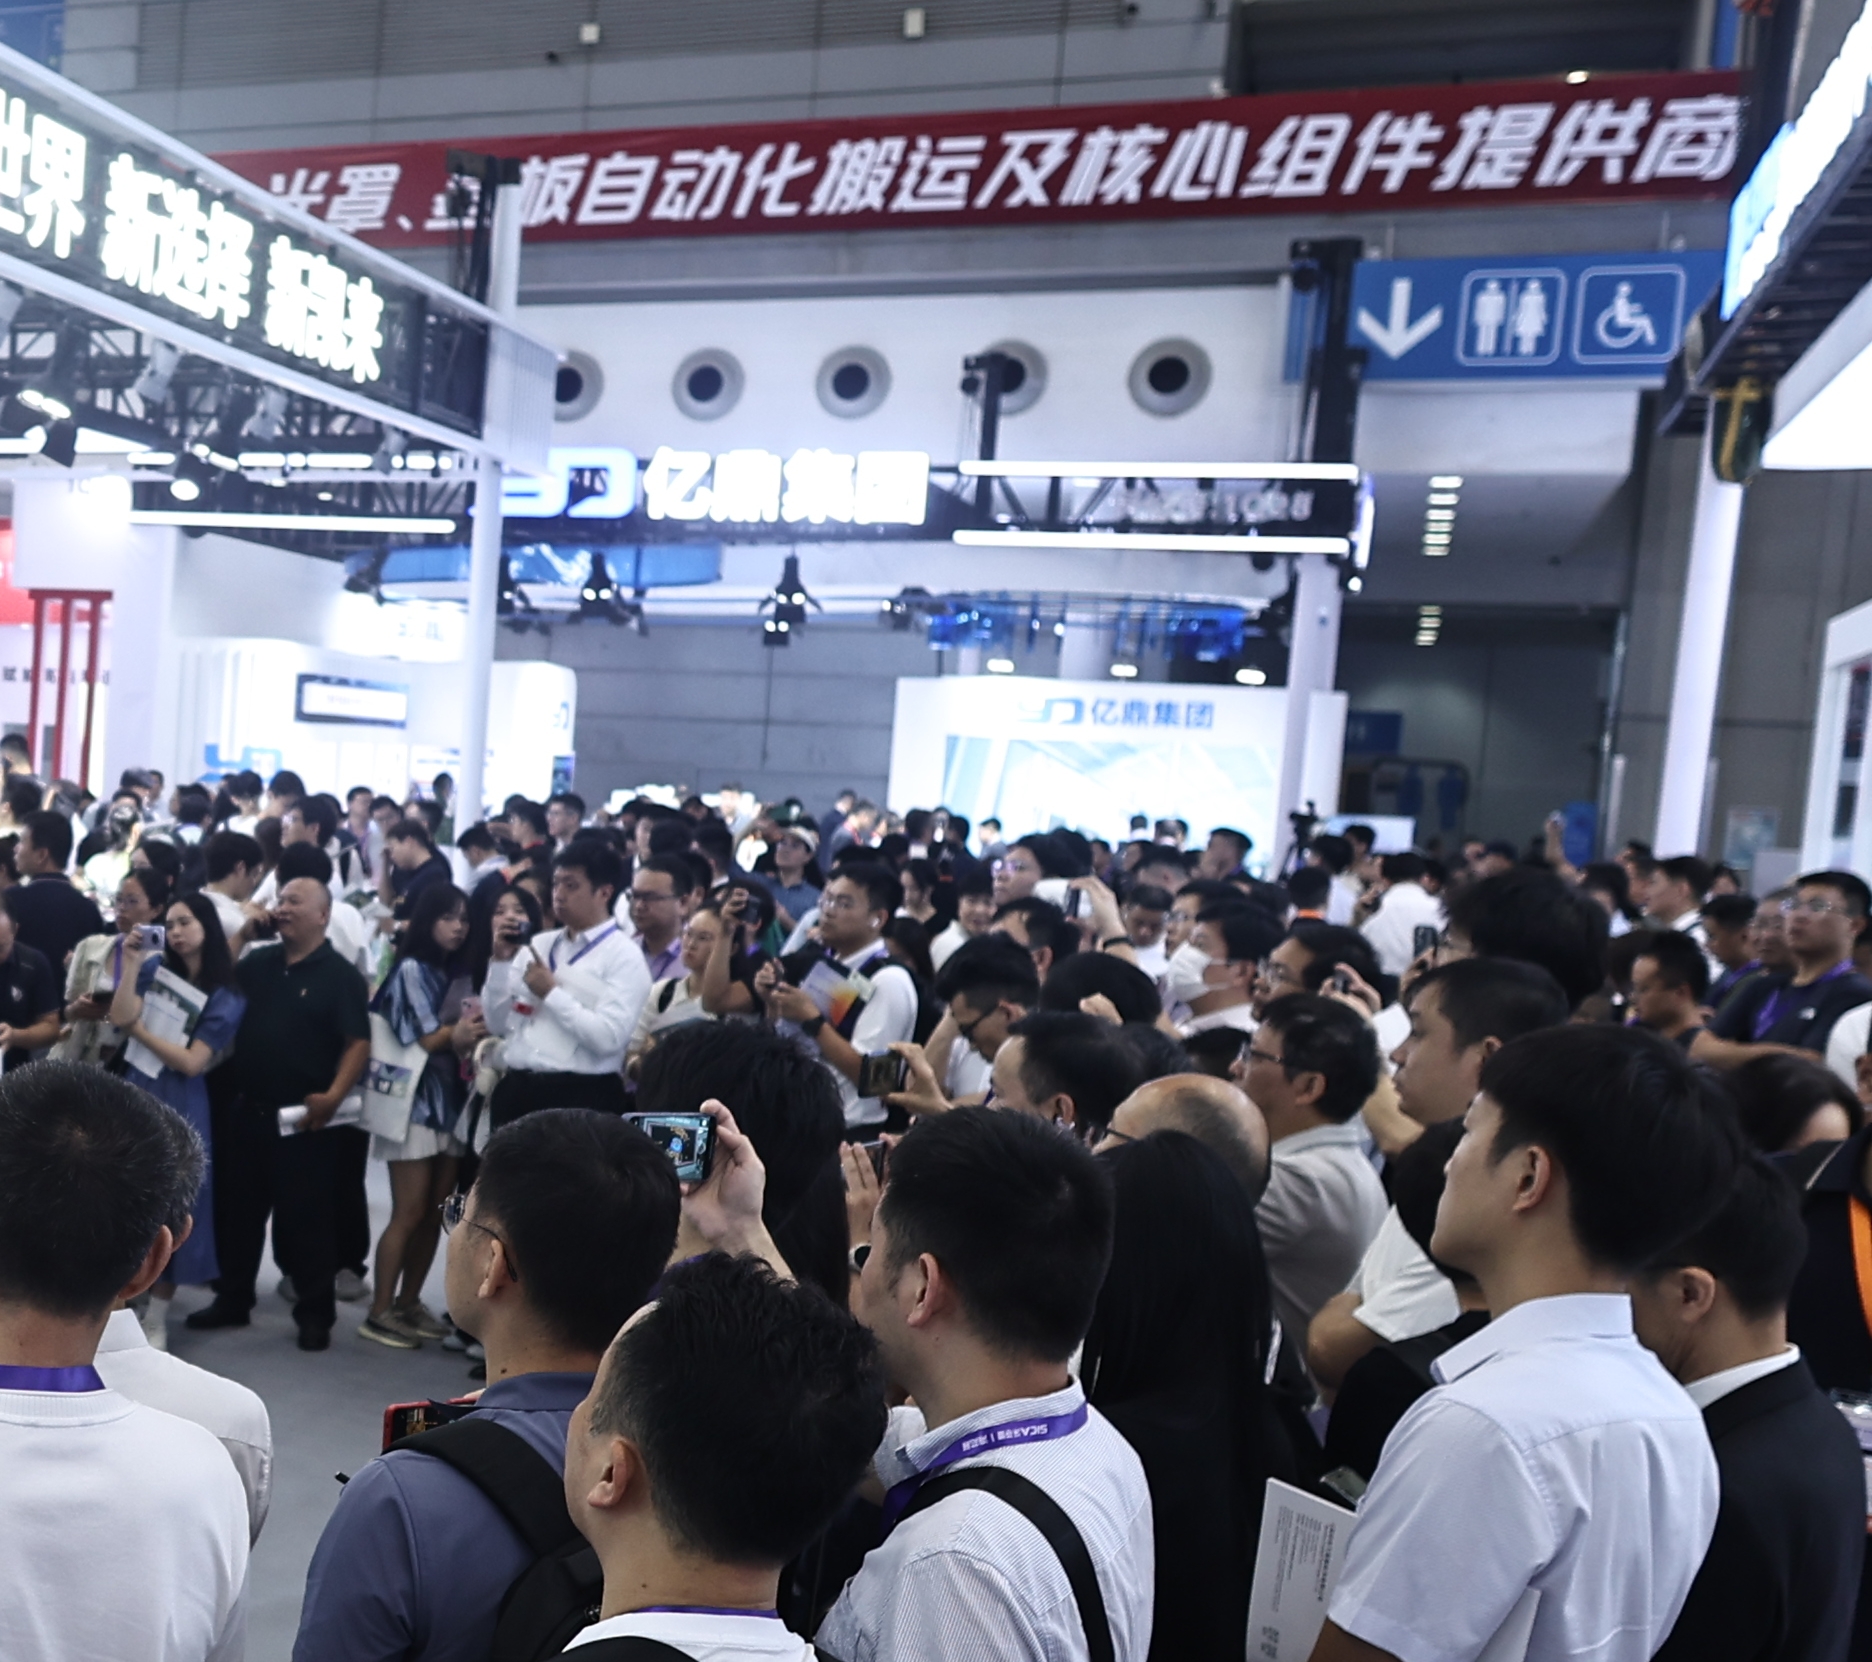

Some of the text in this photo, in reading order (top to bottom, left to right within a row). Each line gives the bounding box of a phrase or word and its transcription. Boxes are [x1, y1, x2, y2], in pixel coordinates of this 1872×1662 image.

[266, 95, 1742, 233] 光罩、板自动化搬运及核心组件提供商
[101, 152, 254, 330] 新选择
[264, 234, 385, 384] 新凯来
[642, 445, 931, 525] 亿鼎集团
[1091, 698, 1216, 730] 亿鼎集团
